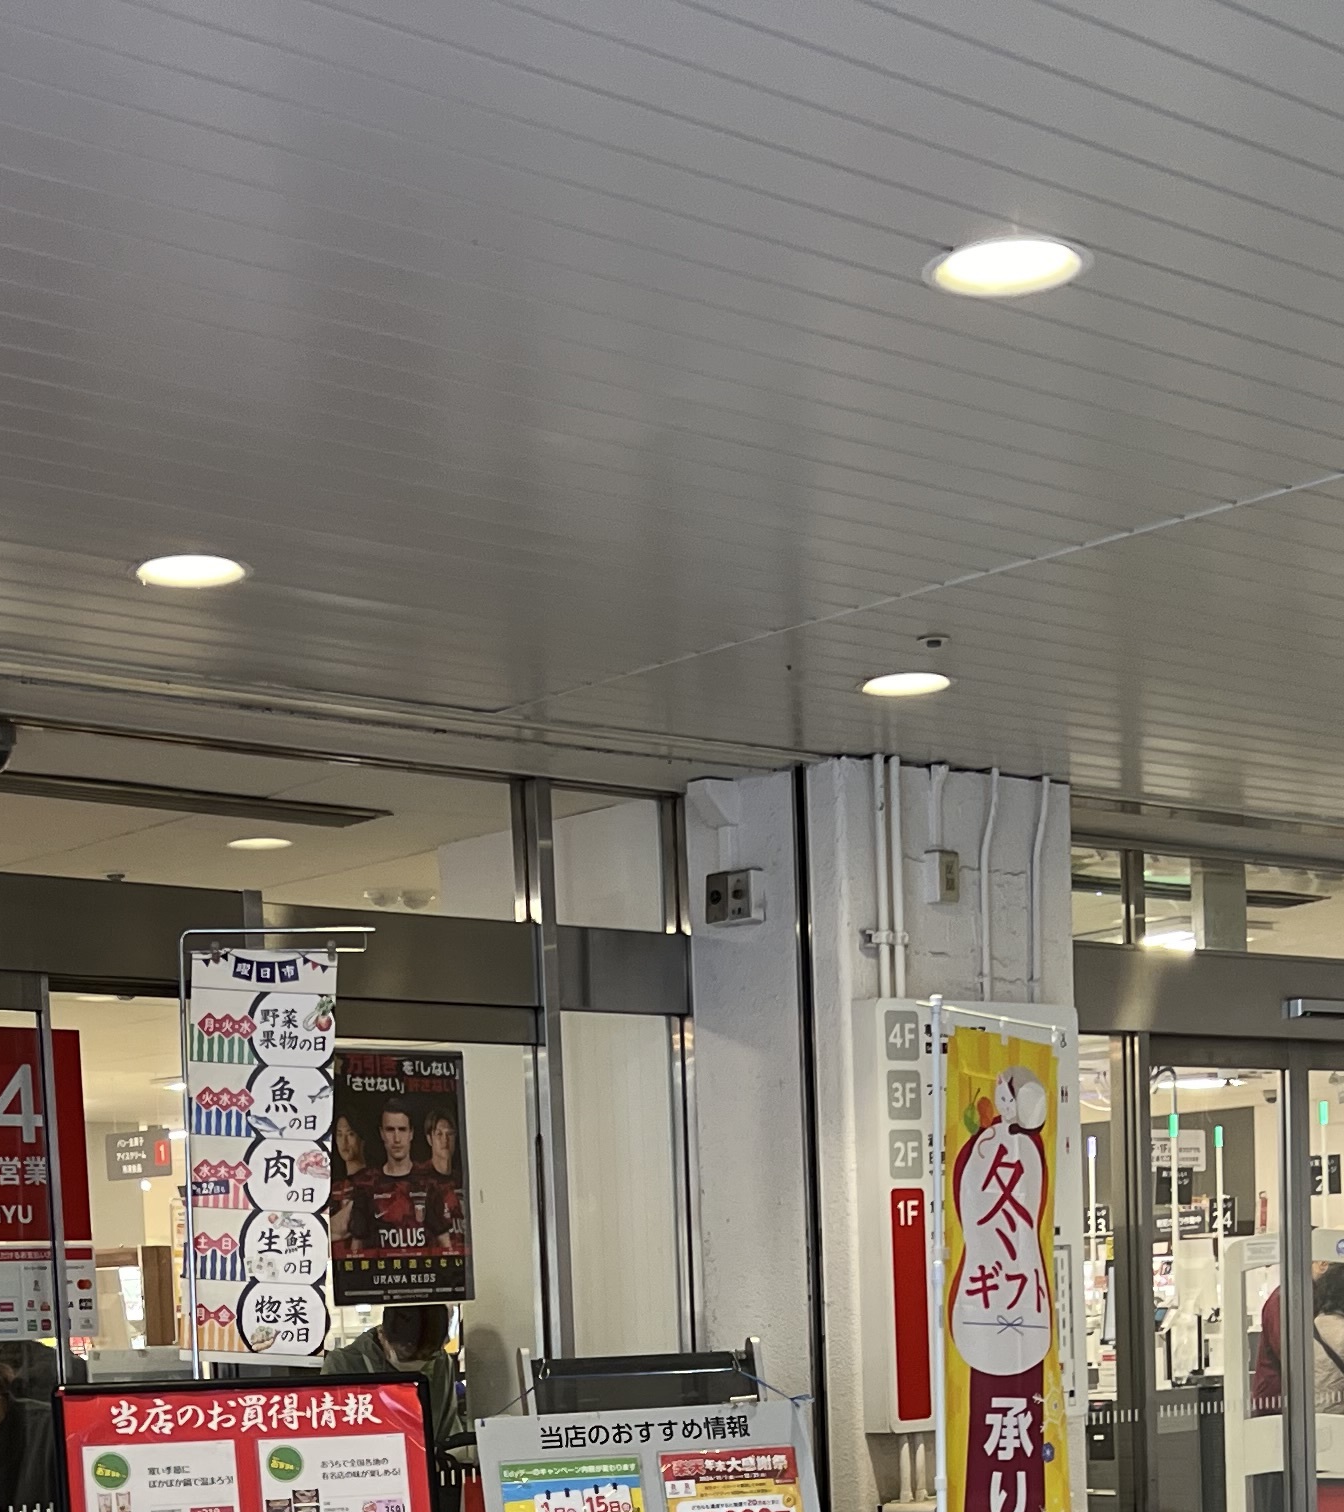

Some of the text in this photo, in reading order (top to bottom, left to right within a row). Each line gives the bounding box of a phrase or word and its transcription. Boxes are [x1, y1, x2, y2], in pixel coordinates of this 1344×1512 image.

[260, 1008, 298, 1028] 野菜
[259, 1031, 326, 1052] 果物の日
[888, 1023, 916, 1049] 4F
[265, 1076, 297, 1113] 魚
[891, 1082, 917, 1108] 3F
[289, 1115, 317, 1131] の日
[159, 1144, 165, 1161] 1
[893, 1141, 918, 1168] 2F
[264, 1150, 295, 1187] 肉
[287, 1188, 314, 1202] の日
[976, 1144, 1034, 1262] 冬
[897, 1200, 919, 1226] 1F
[258, 1228, 313, 1257] 生鮮
[379, 1228, 425, 1248] POLUS
[284, 1260, 312, 1274] の日
[373, 1273, 437, 1285] URAWA REDS
[966, 1263, 1047, 1315] ギフト
[255, 1295, 309, 1325] 惣菜
[281, 1328, 309, 1342] の日
[111, 1392, 382, 1434] 当店のお買得情報
[540, 1415, 750, 1450] 当店のおすすめ情報
